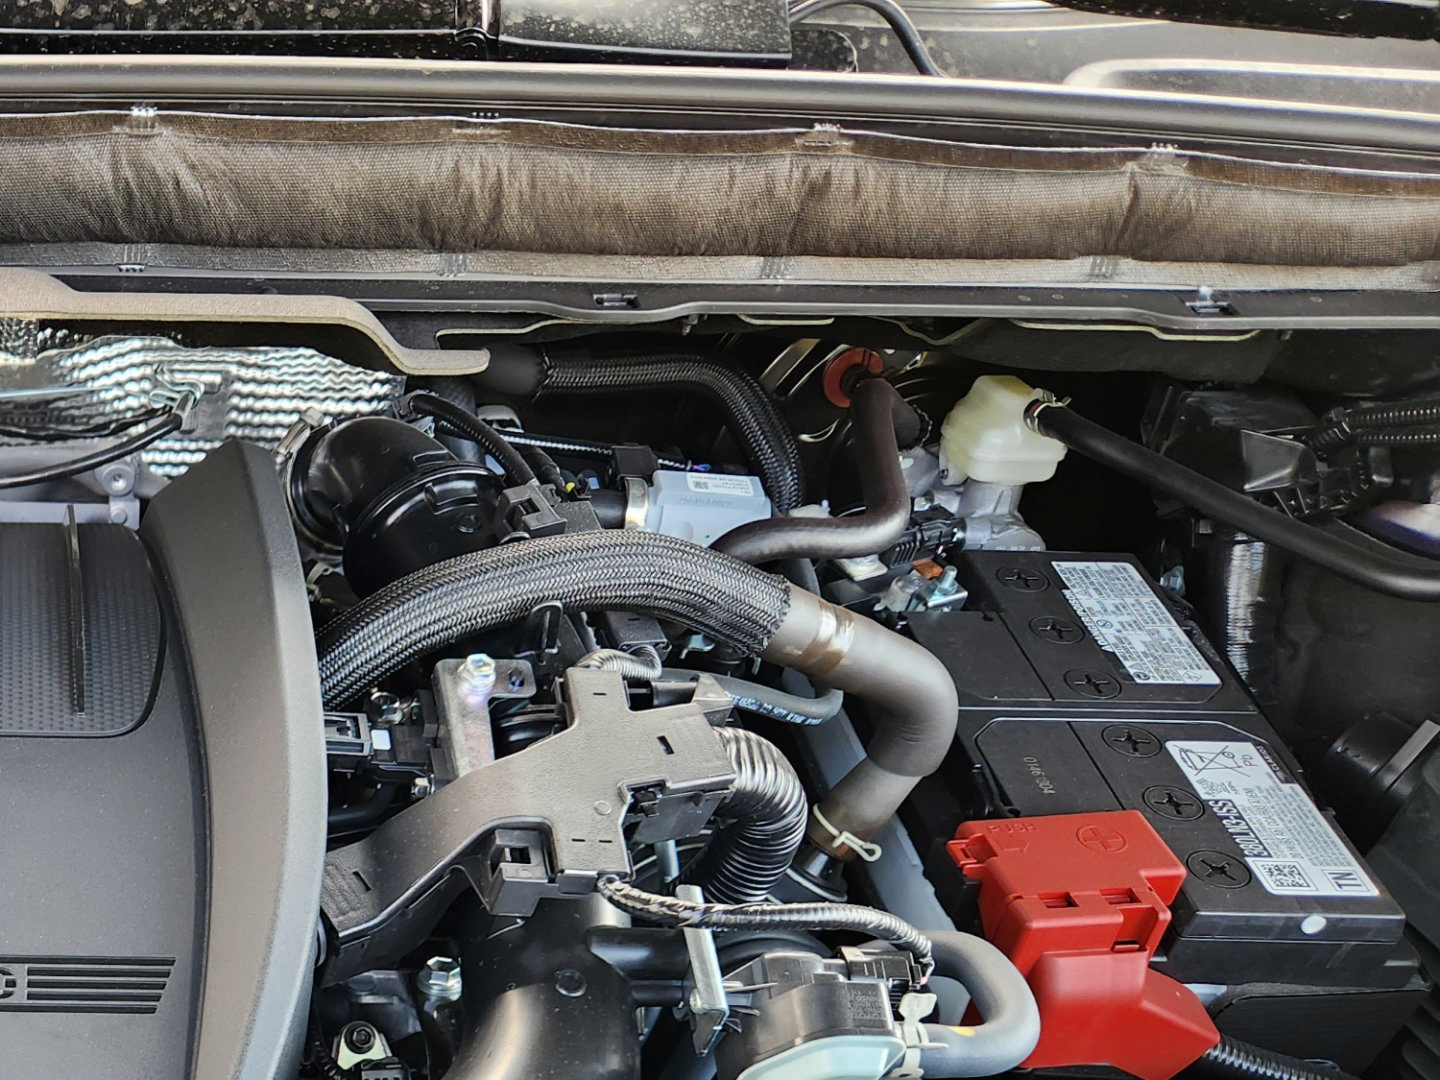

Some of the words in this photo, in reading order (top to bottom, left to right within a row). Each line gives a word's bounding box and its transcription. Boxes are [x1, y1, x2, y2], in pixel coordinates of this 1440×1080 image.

[1241, 754, 1258, 767] Pb
[1256, 745, 1280, 772] CLARIOS
[1208, 800, 1269, 856] 380LN3-ISS
[1330, 872, 1362, 890] TN
